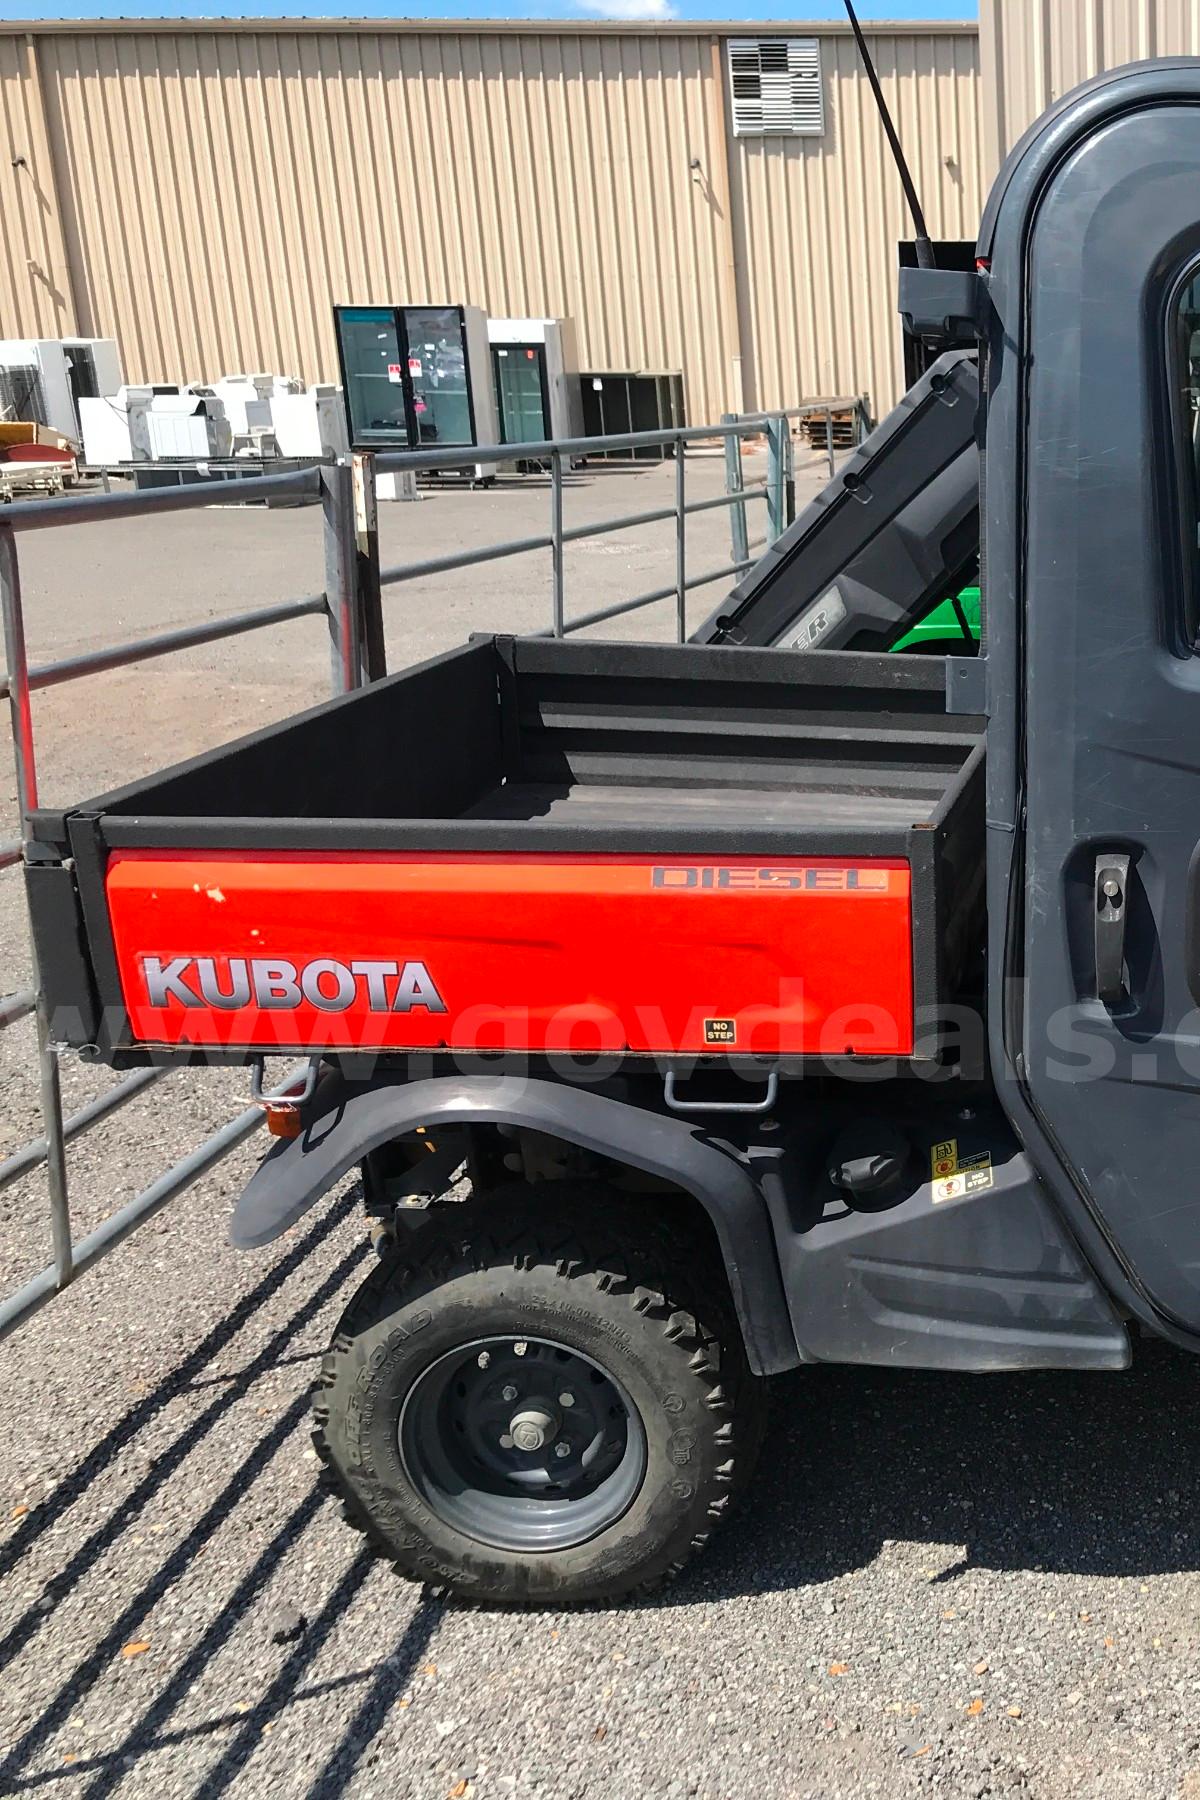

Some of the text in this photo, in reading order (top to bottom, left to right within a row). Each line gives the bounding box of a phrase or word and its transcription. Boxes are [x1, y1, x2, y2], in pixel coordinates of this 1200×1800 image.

[652, 867, 887, 890] DIESEL
[143, 956, 448, 1013] KUBOTA
[713, 1022, 728, 1030] NO
[707, 1031, 733, 1039] STEP
[967, 1176, 989, 1188] STEP
[971, 1172, 985, 1181] NO
[356, 1309, 433, 1393] ROAD
